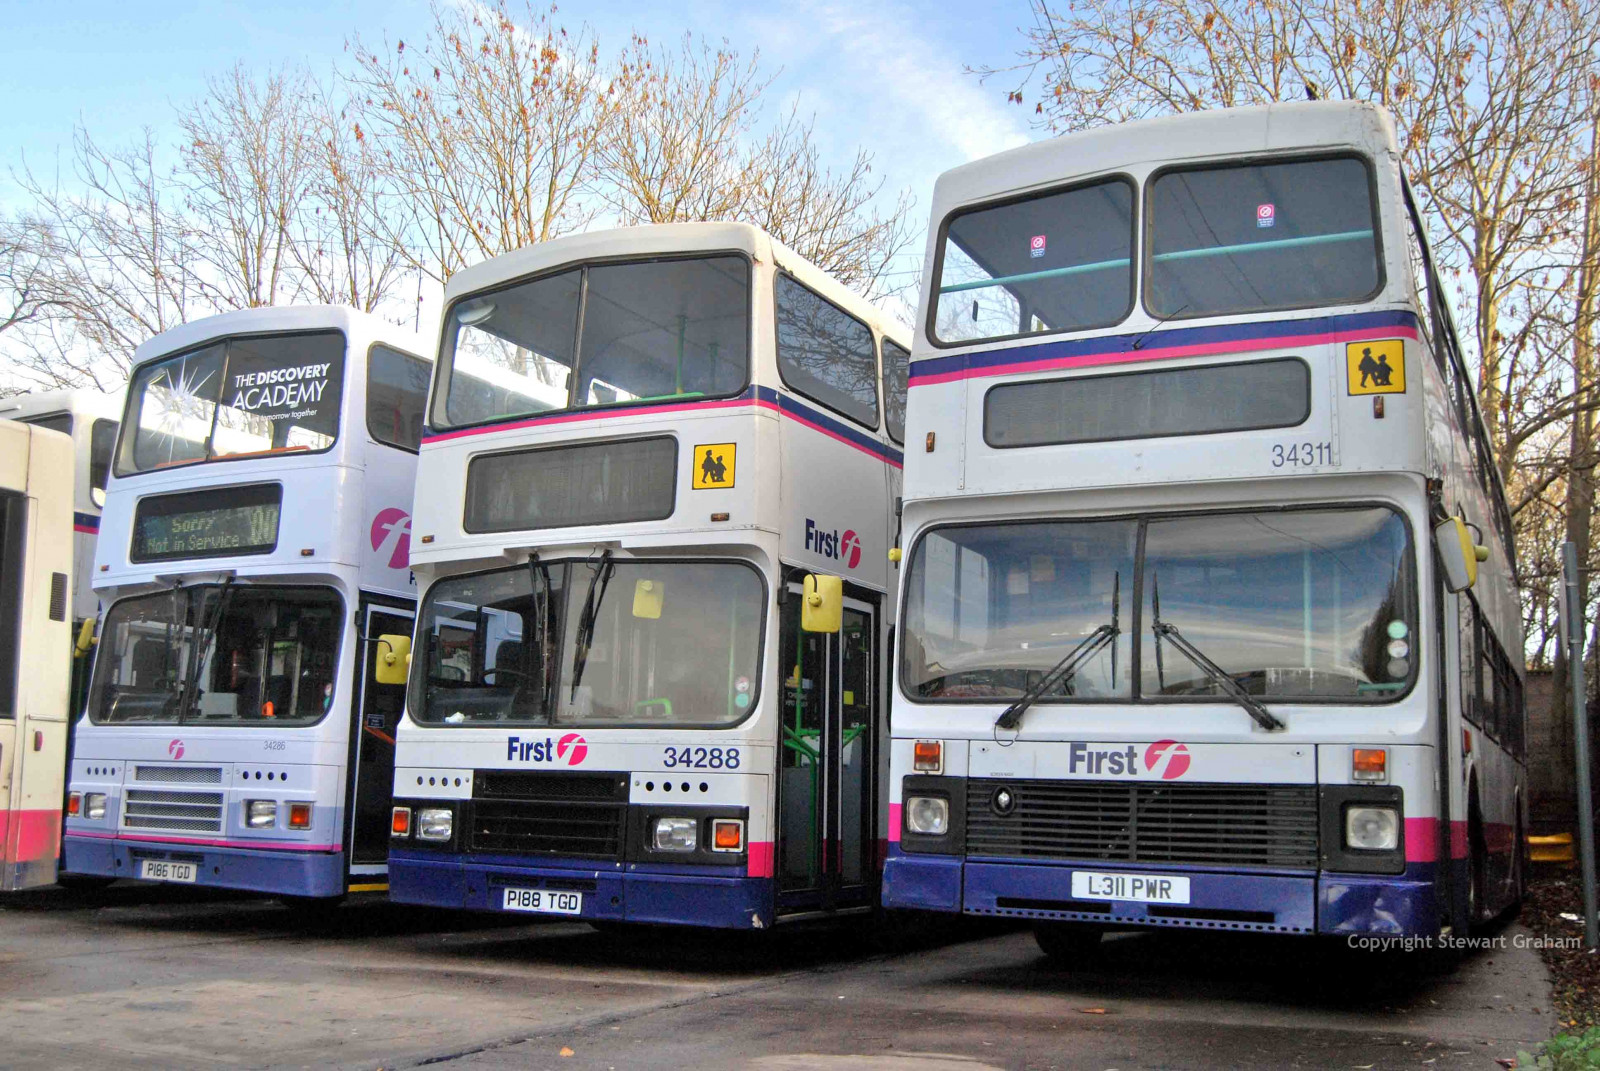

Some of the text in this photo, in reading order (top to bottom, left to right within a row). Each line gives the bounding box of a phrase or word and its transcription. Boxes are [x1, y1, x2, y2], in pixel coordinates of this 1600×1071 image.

[235, 362, 331, 388] THE DISCOVERY
[232, 379, 328, 410] ACADEMY
[291, 407, 318, 420] together
[1272, 441, 1332, 468] 34311
[171, 516, 216, 533] Sorry
[147, 531, 240, 554] Not in Service
[805, 517, 839, 561] First
[263, 740, 286, 751] 34286
[507, 736, 553, 762] First
[663, 746, 741, 769] 34288
[1069, 742, 1137, 775] First
[147, 863, 190, 879] P186 TGD
[1088, 876, 1172, 899] L311 PWR
[507, 890, 578, 910] P188 TGD
